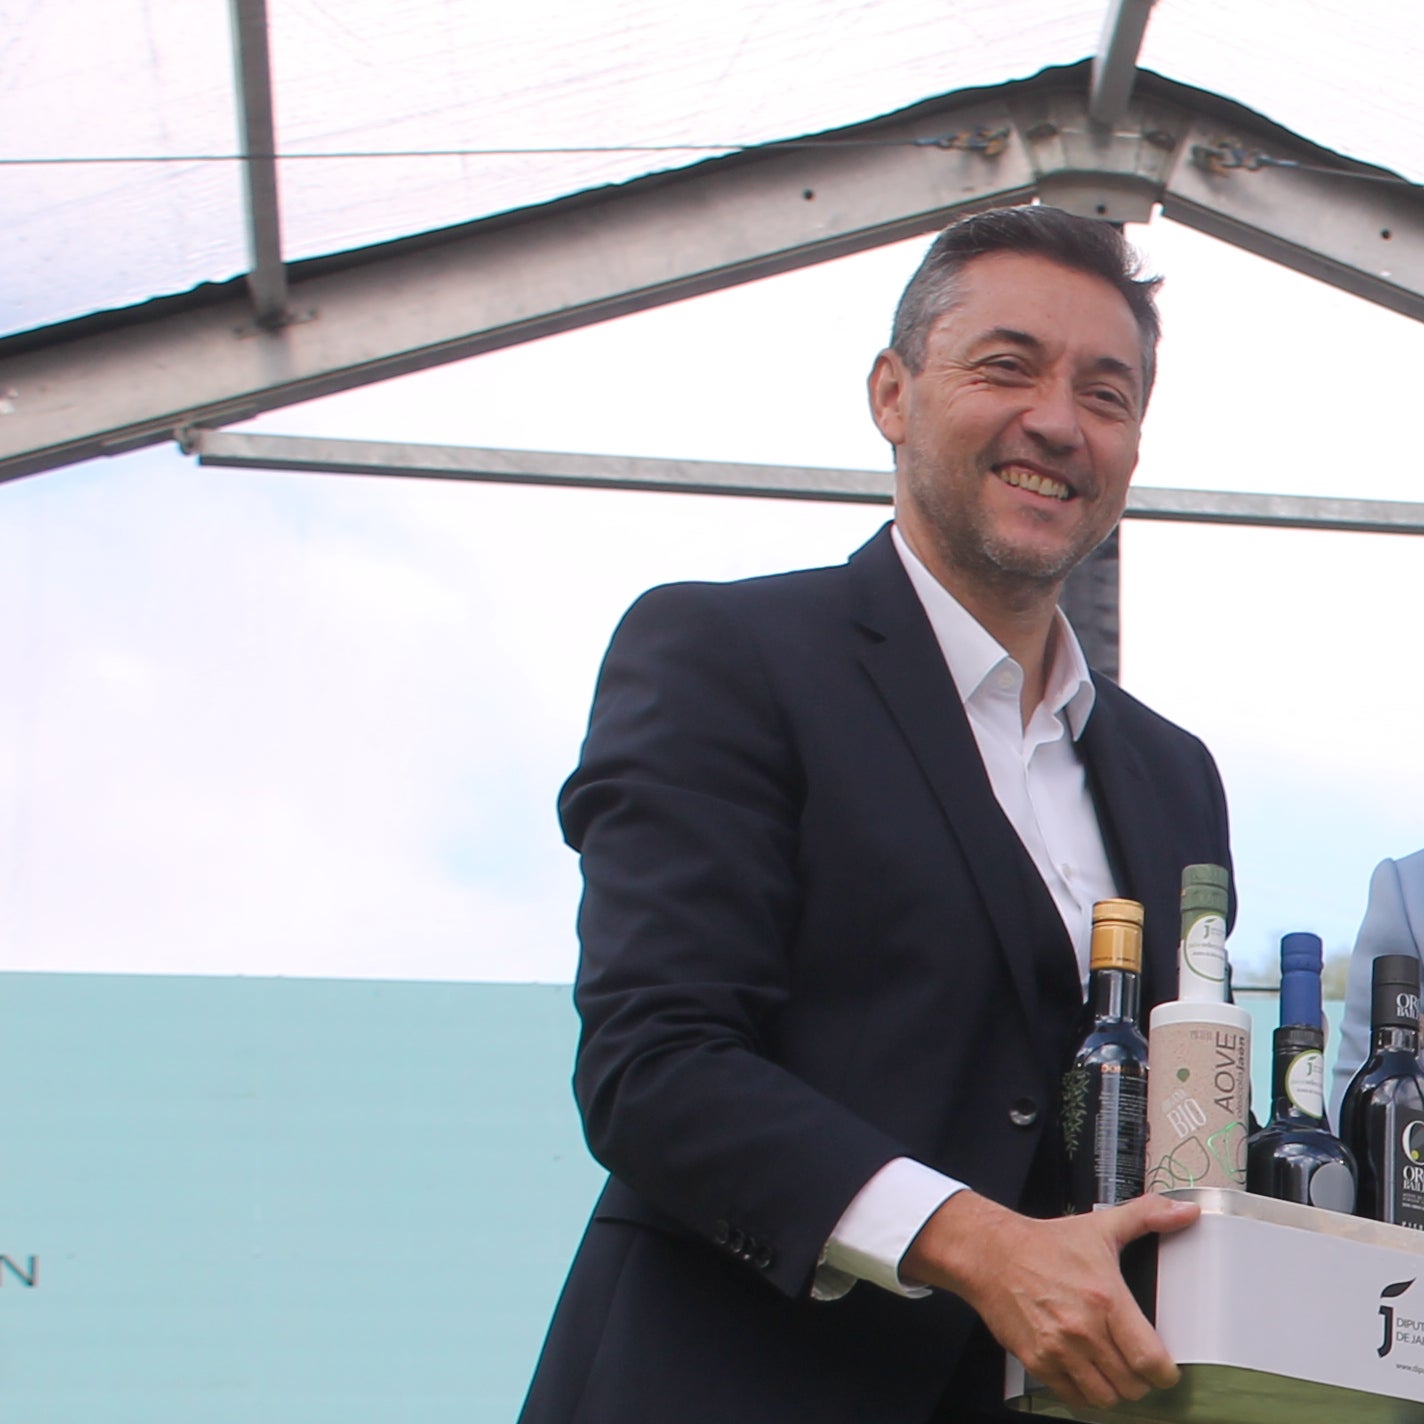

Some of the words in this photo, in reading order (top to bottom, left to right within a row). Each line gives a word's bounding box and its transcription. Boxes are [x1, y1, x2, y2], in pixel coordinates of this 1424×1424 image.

[1213, 1031, 1238, 1115] AOVE
[1166, 1097, 1209, 1139] BIO
[1395, 1331, 1410, 1343] DE
